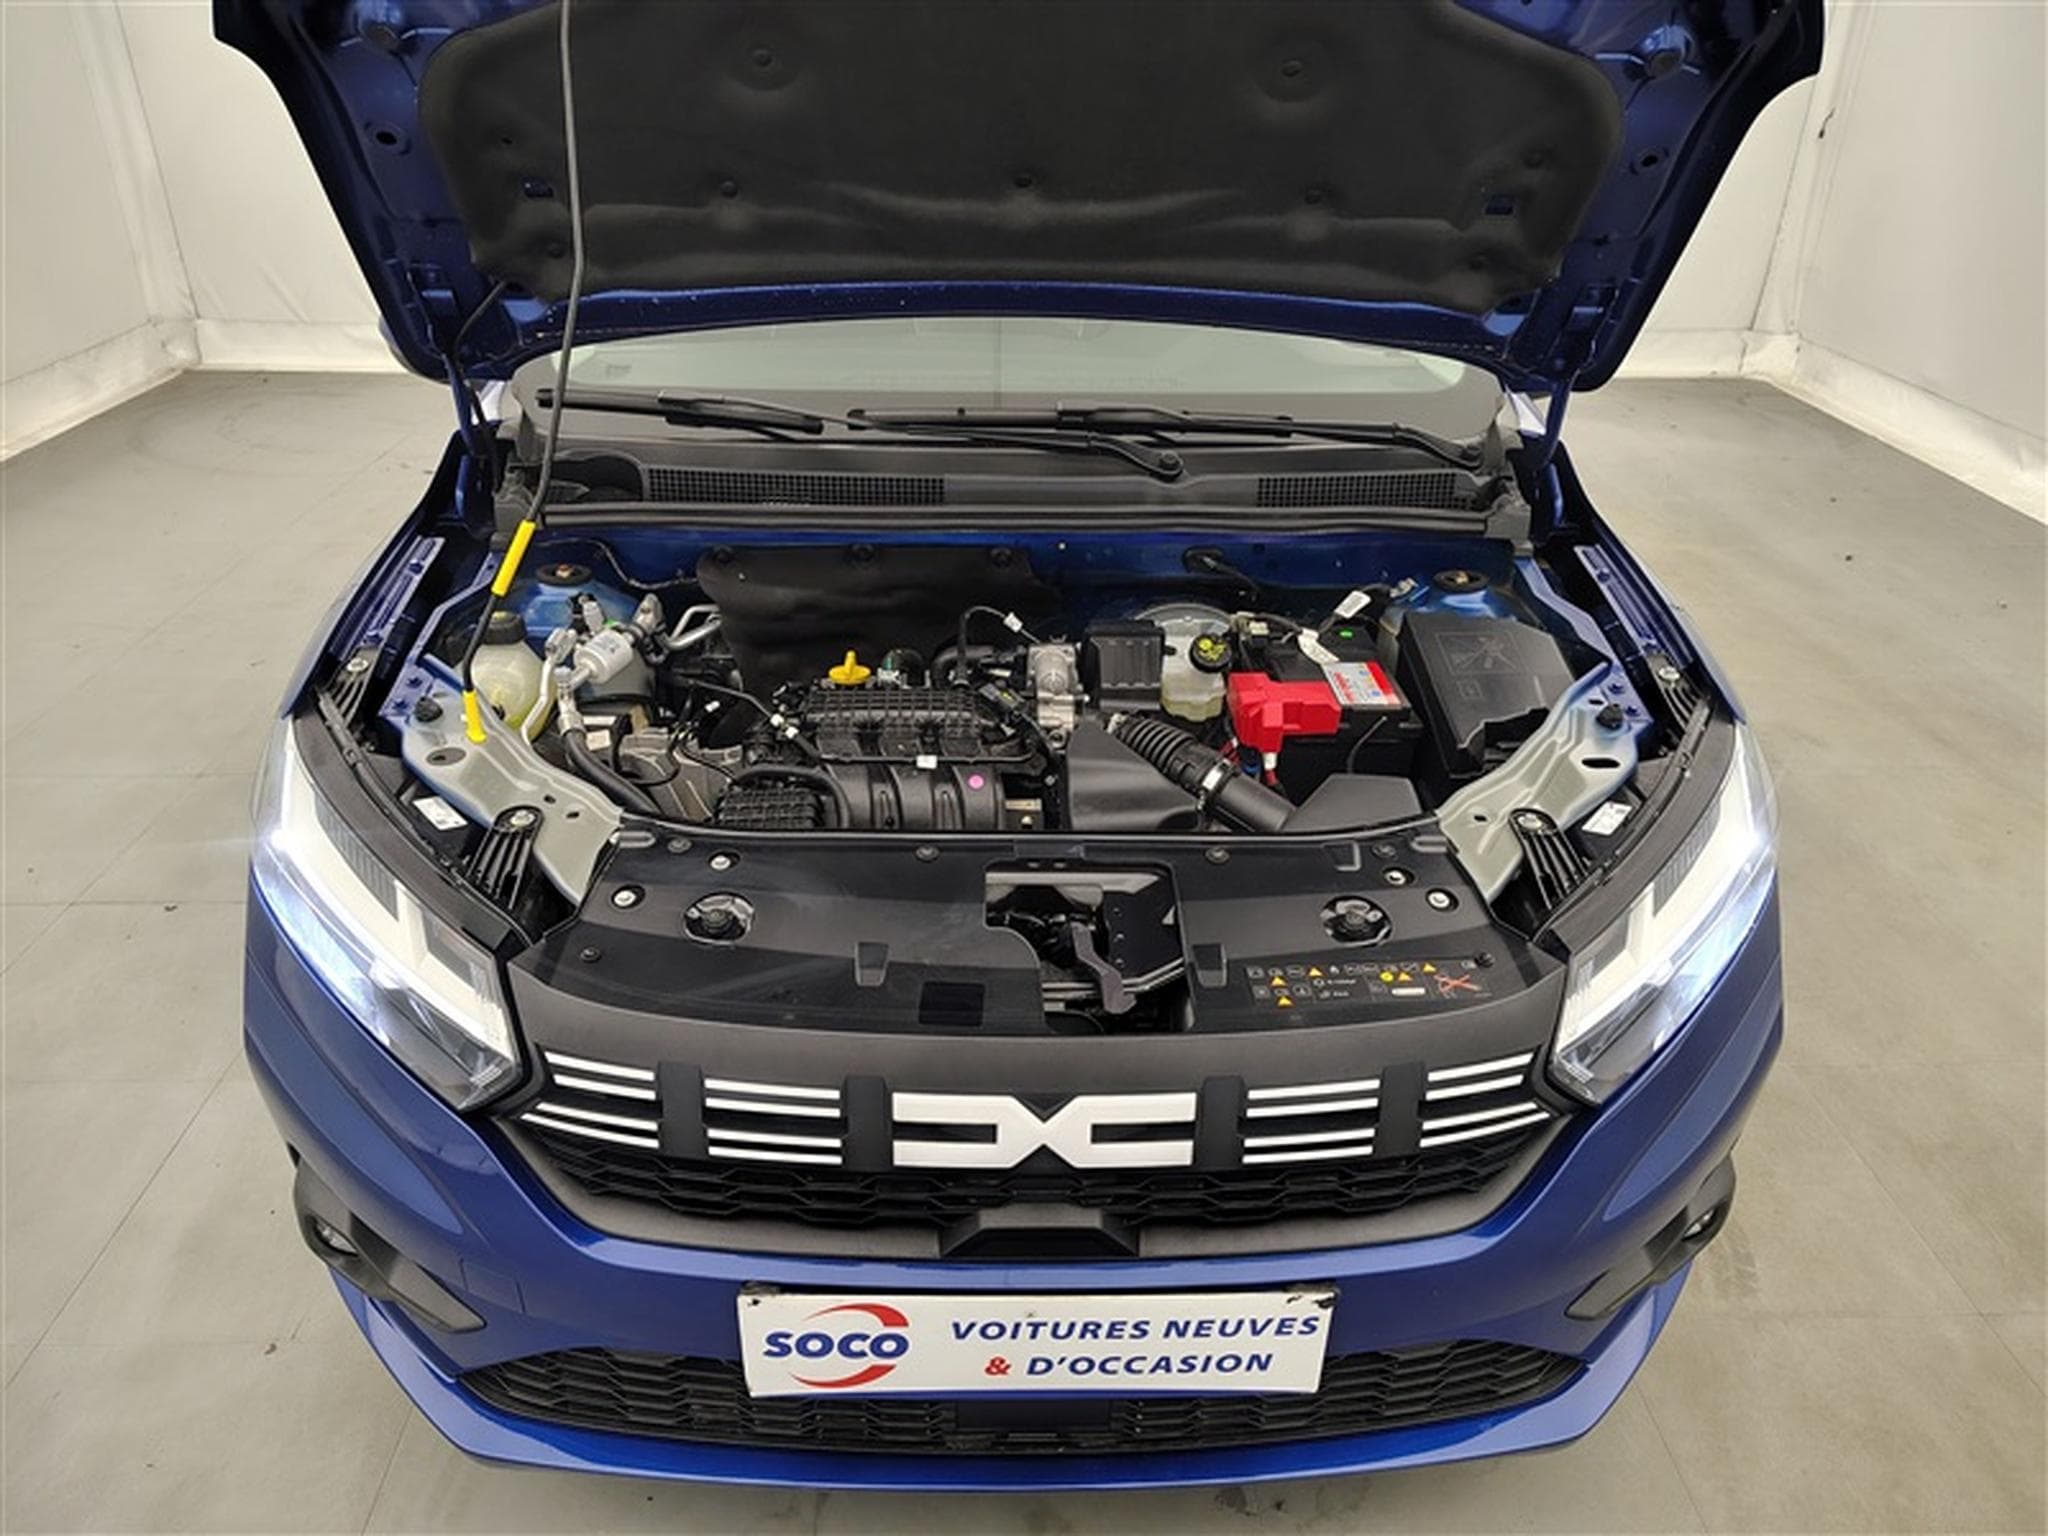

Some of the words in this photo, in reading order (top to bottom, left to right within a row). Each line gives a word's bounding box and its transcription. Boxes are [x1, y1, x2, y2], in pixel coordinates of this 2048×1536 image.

[951, 1320, 1150, 1341] VOITURES
[1162, 1316, 1320, 1339] NEUVES
[763, 1331, 910, 1359] SOCO
[984, 1356, 1012, 1376] &
[1026, 1353, 1273, 1376] D'OCCASION
